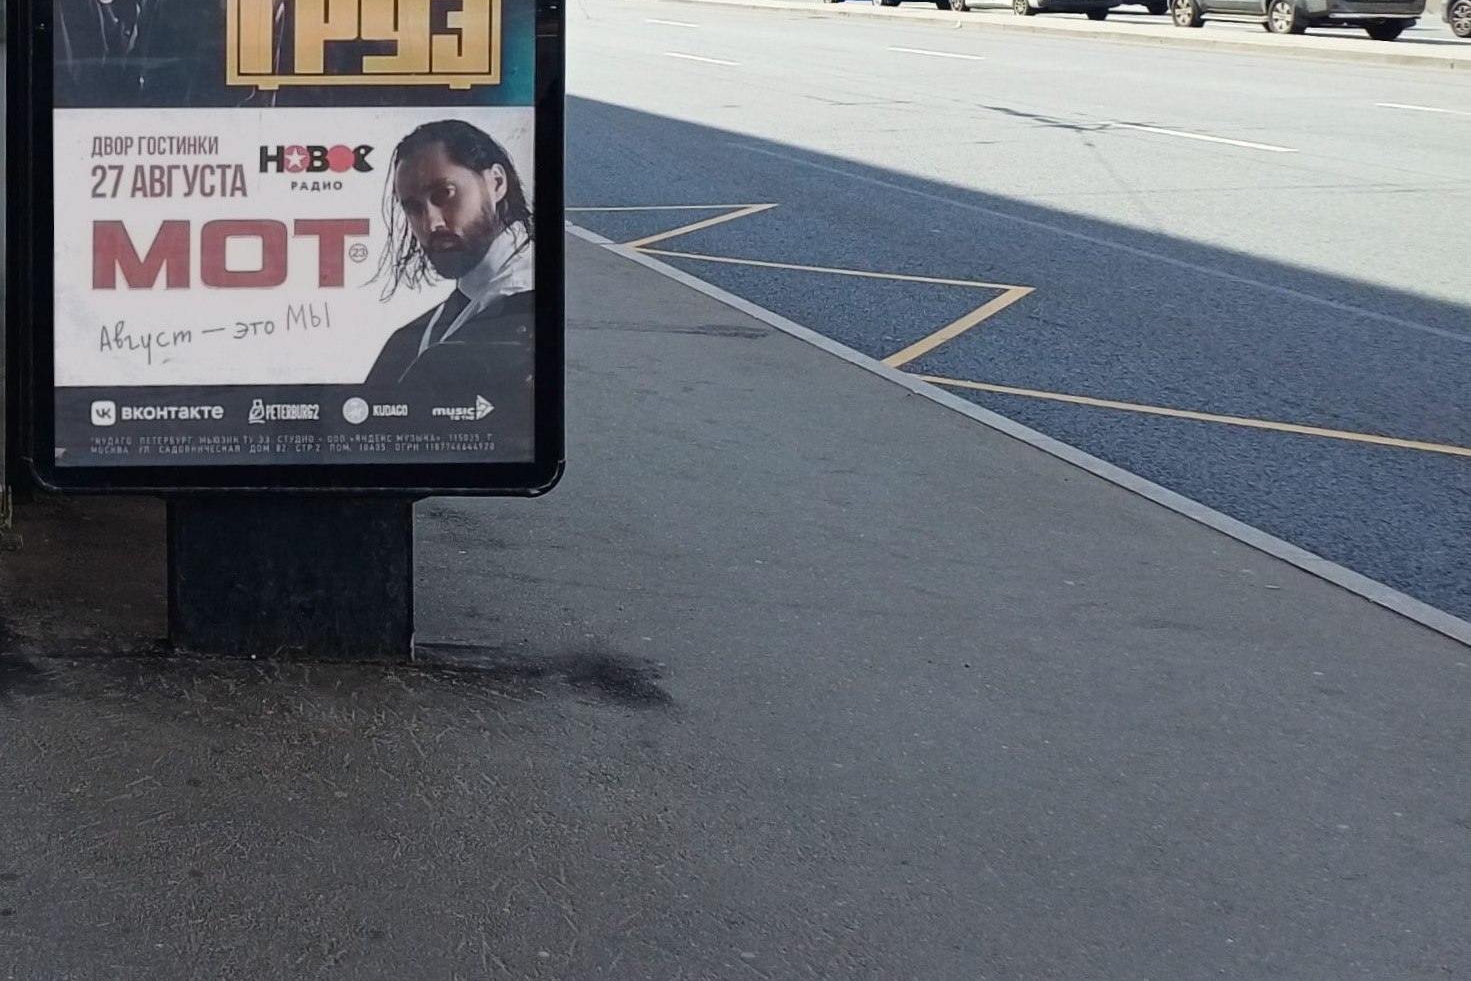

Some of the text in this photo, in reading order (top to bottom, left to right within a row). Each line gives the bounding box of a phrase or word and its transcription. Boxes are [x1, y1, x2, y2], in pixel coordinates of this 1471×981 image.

[90, 136, 219, 158] ДВОР ГОСТИНКИ
[91, 164, 248, 198] 27 АВГУСТА
[290, 180, 343, 192] РАДИО
[92, 218, 370, 290] МОТ
[100, 320, 192, 365] Август
